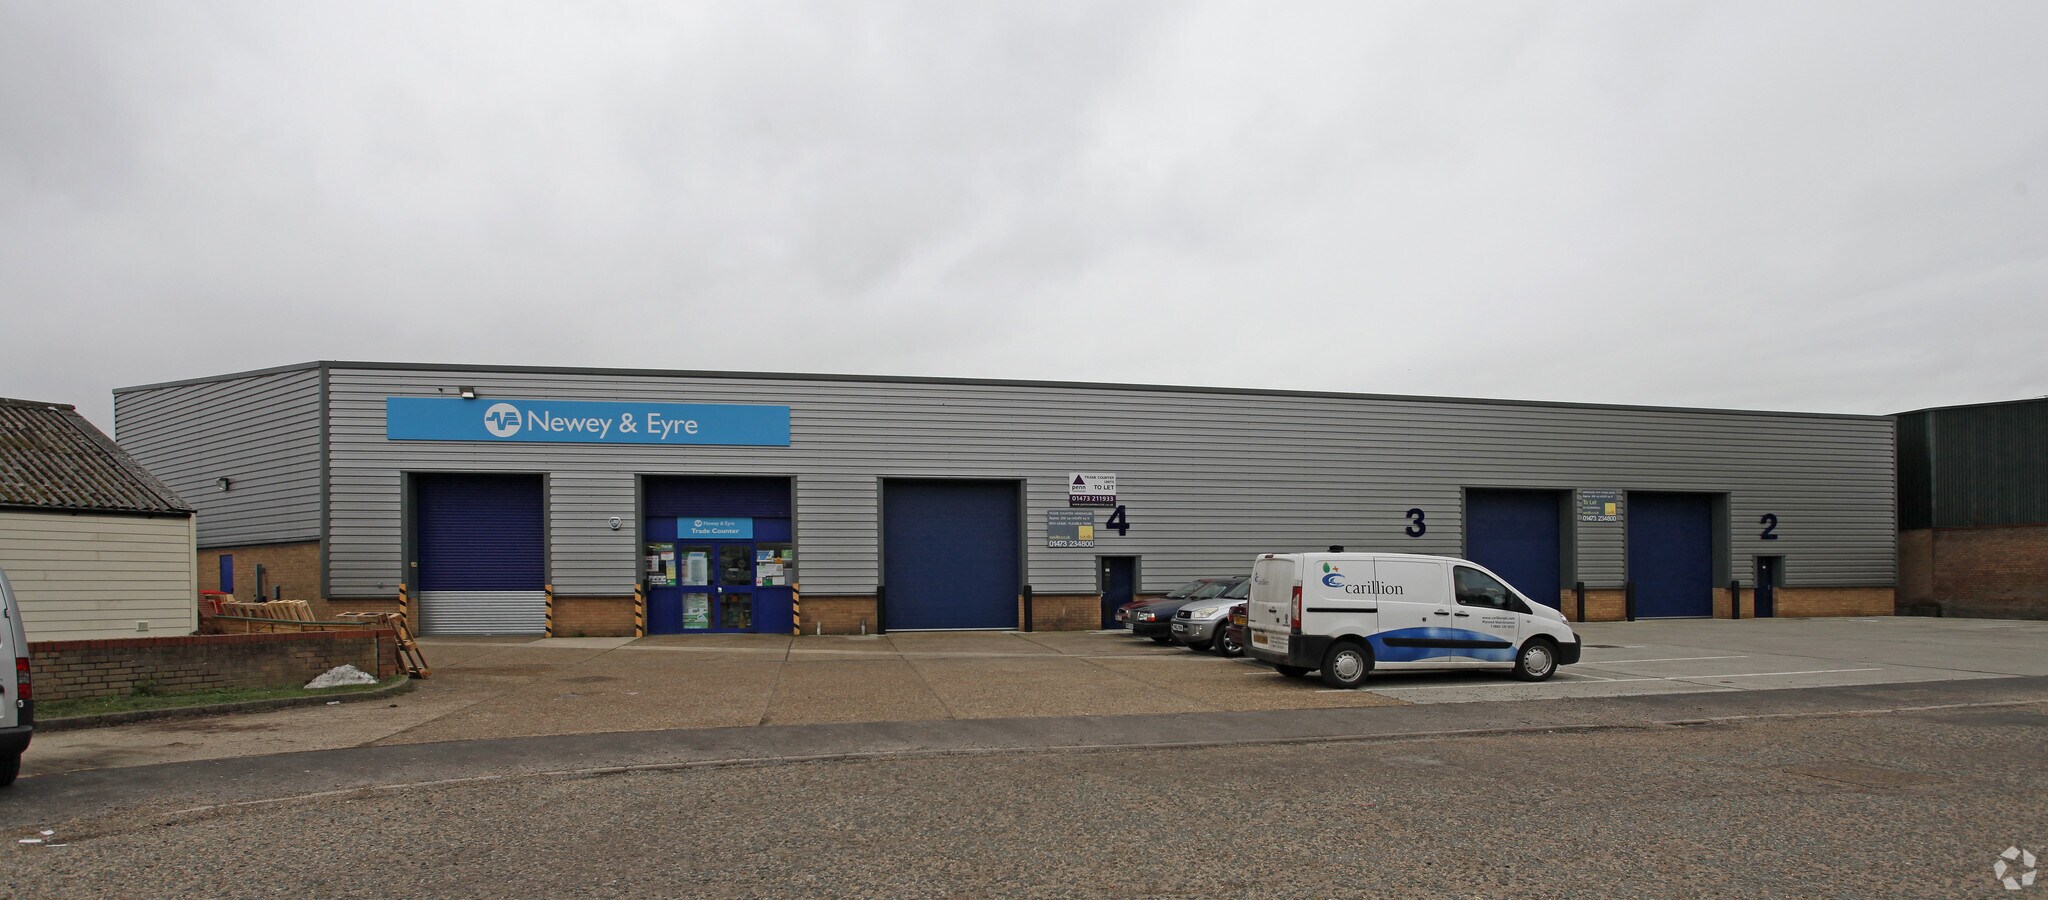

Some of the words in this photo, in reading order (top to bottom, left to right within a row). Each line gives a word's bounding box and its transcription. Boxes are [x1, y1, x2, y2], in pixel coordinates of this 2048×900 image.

[527, 409, 613, 439] Newey
[619, 412, 637, 433] &
[647, 412, 698, 440] Eyre
[1106, 504, 1130, 536] 4
[1406, 507, 1426, 538] 3
[1760, 513, 1778, 540] 2
[1345, 580, 1404, 596] carillion
